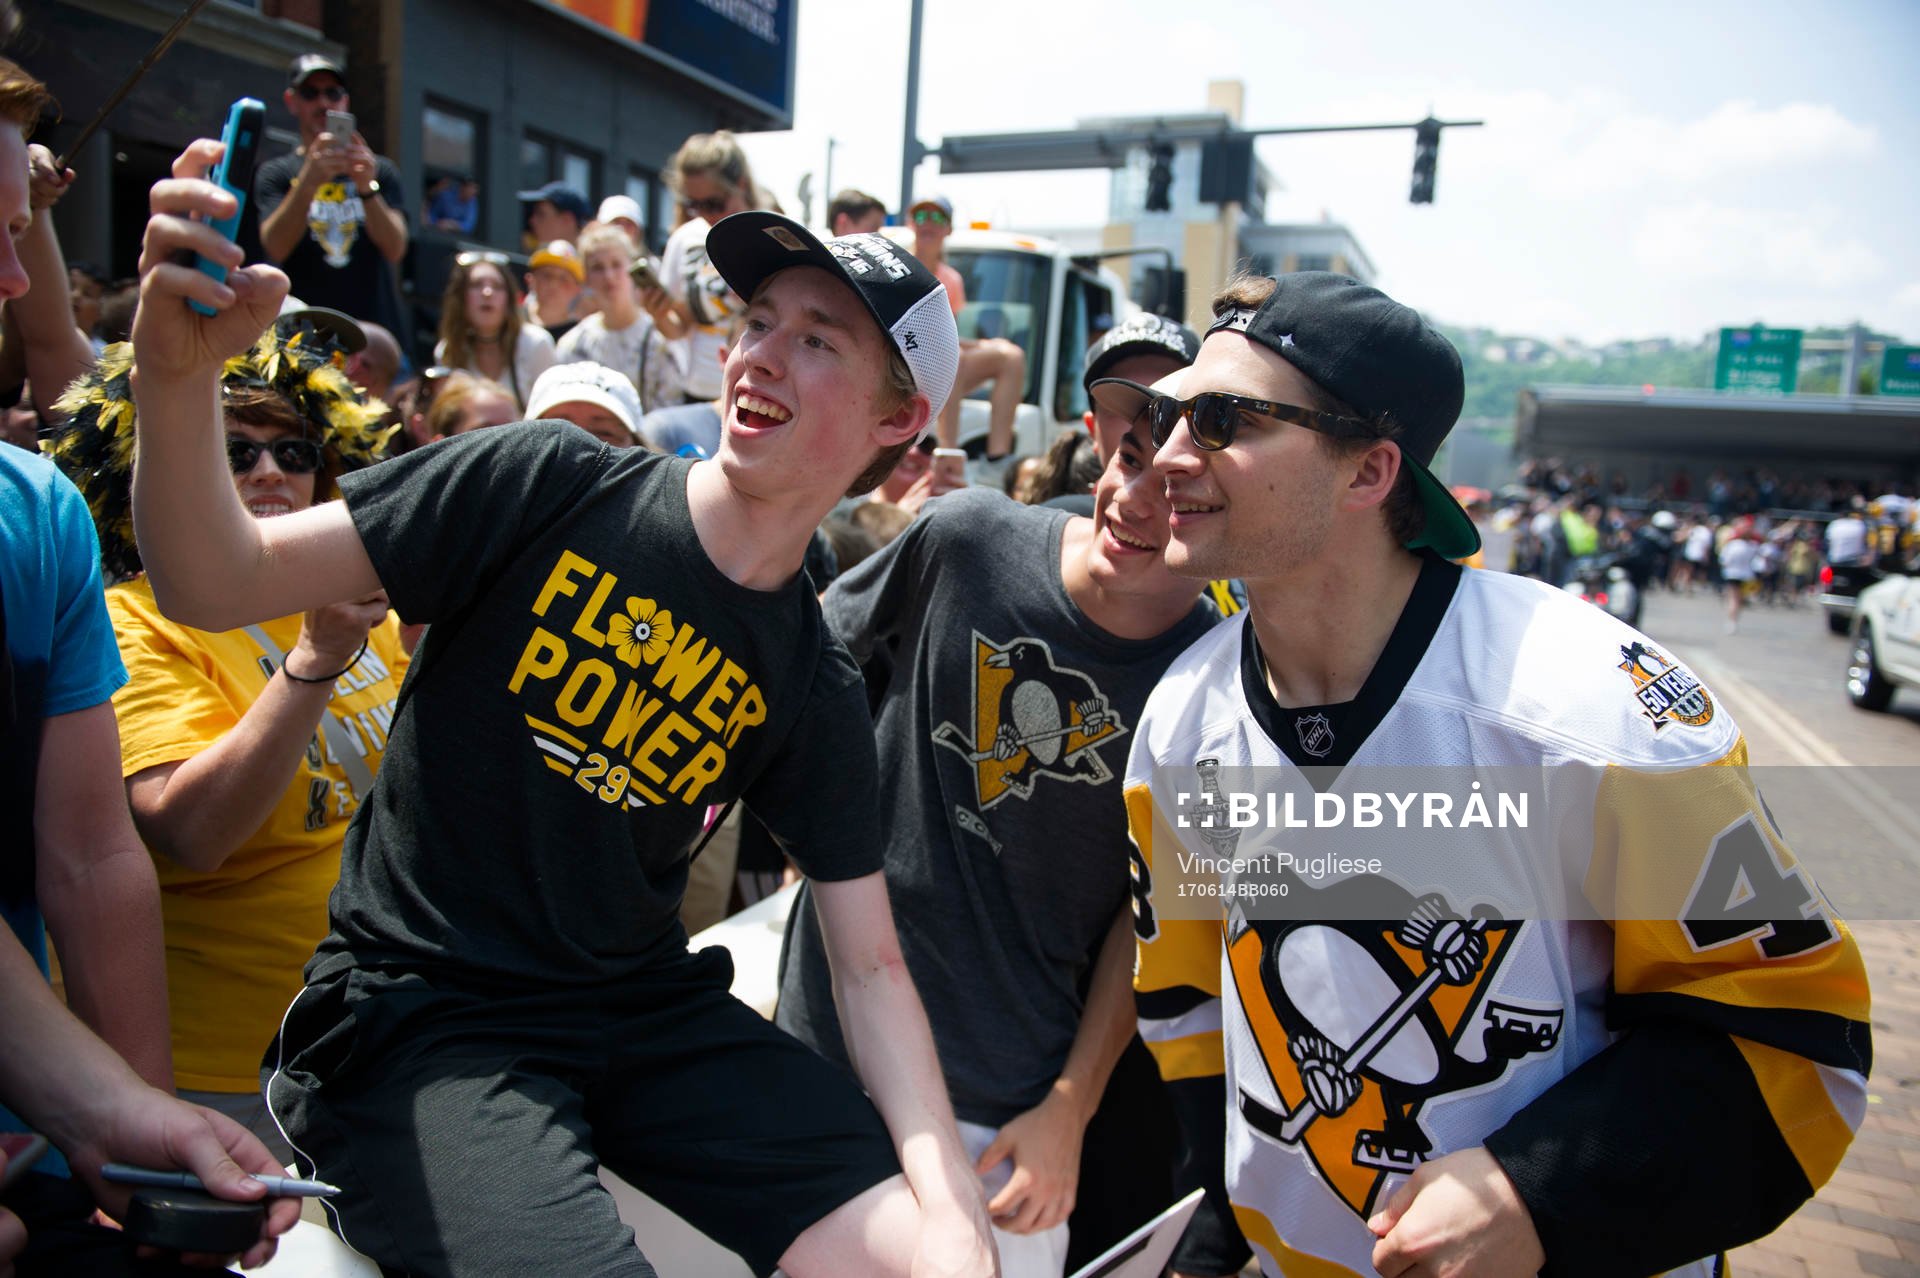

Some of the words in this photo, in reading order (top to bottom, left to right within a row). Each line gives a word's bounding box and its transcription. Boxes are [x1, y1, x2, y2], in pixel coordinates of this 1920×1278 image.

[507, 626, 726, 805] POWER
[1638, 685, 1671, 714] 50
[1307, 725, 1325, 749] NHL
[574, 752, 631, 804] 29
[1677, 787, 1842, 961] 4
